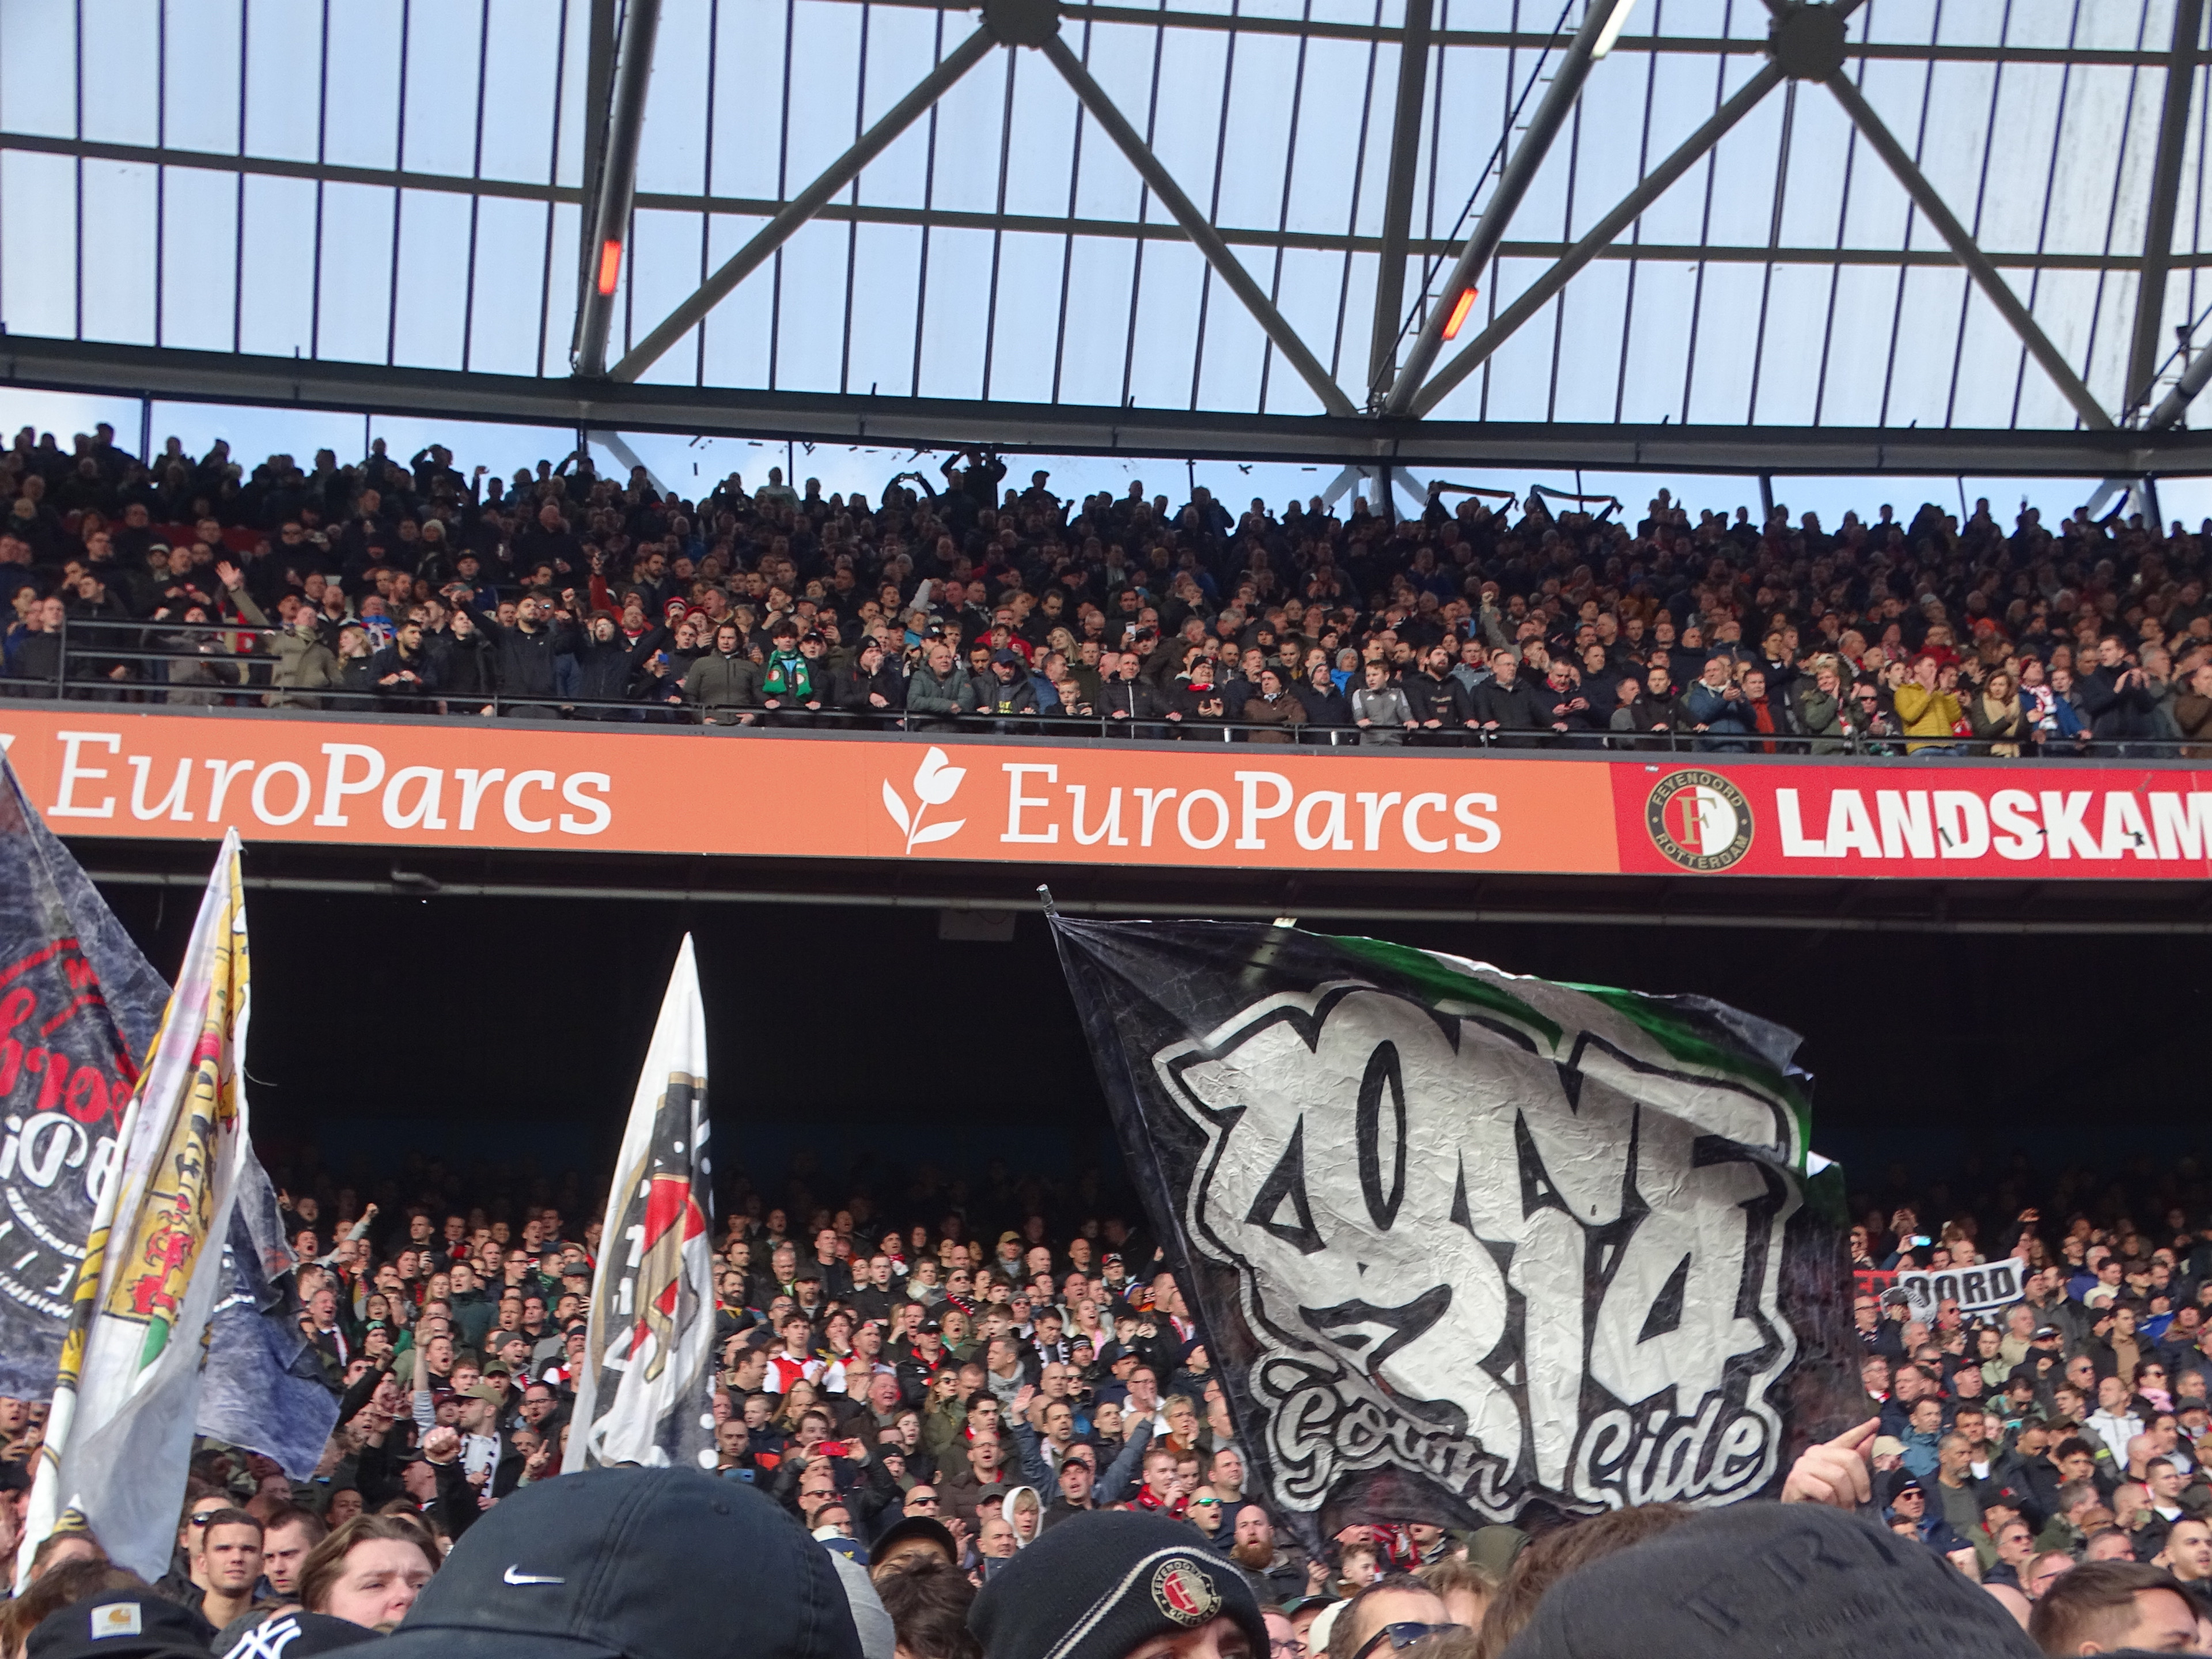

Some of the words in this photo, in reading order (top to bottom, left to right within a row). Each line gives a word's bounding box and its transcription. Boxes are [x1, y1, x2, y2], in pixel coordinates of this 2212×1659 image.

[47, 731, 612, 835] EuroParcs
[1000, 763, 1501, 853] EuroParcs
[1652, 772, 1743, 807] FEYENOORD
[1656, 832, 1749, 869] ROTTERDAM
[1776, 788, 2212, 859] LANDSKAM
